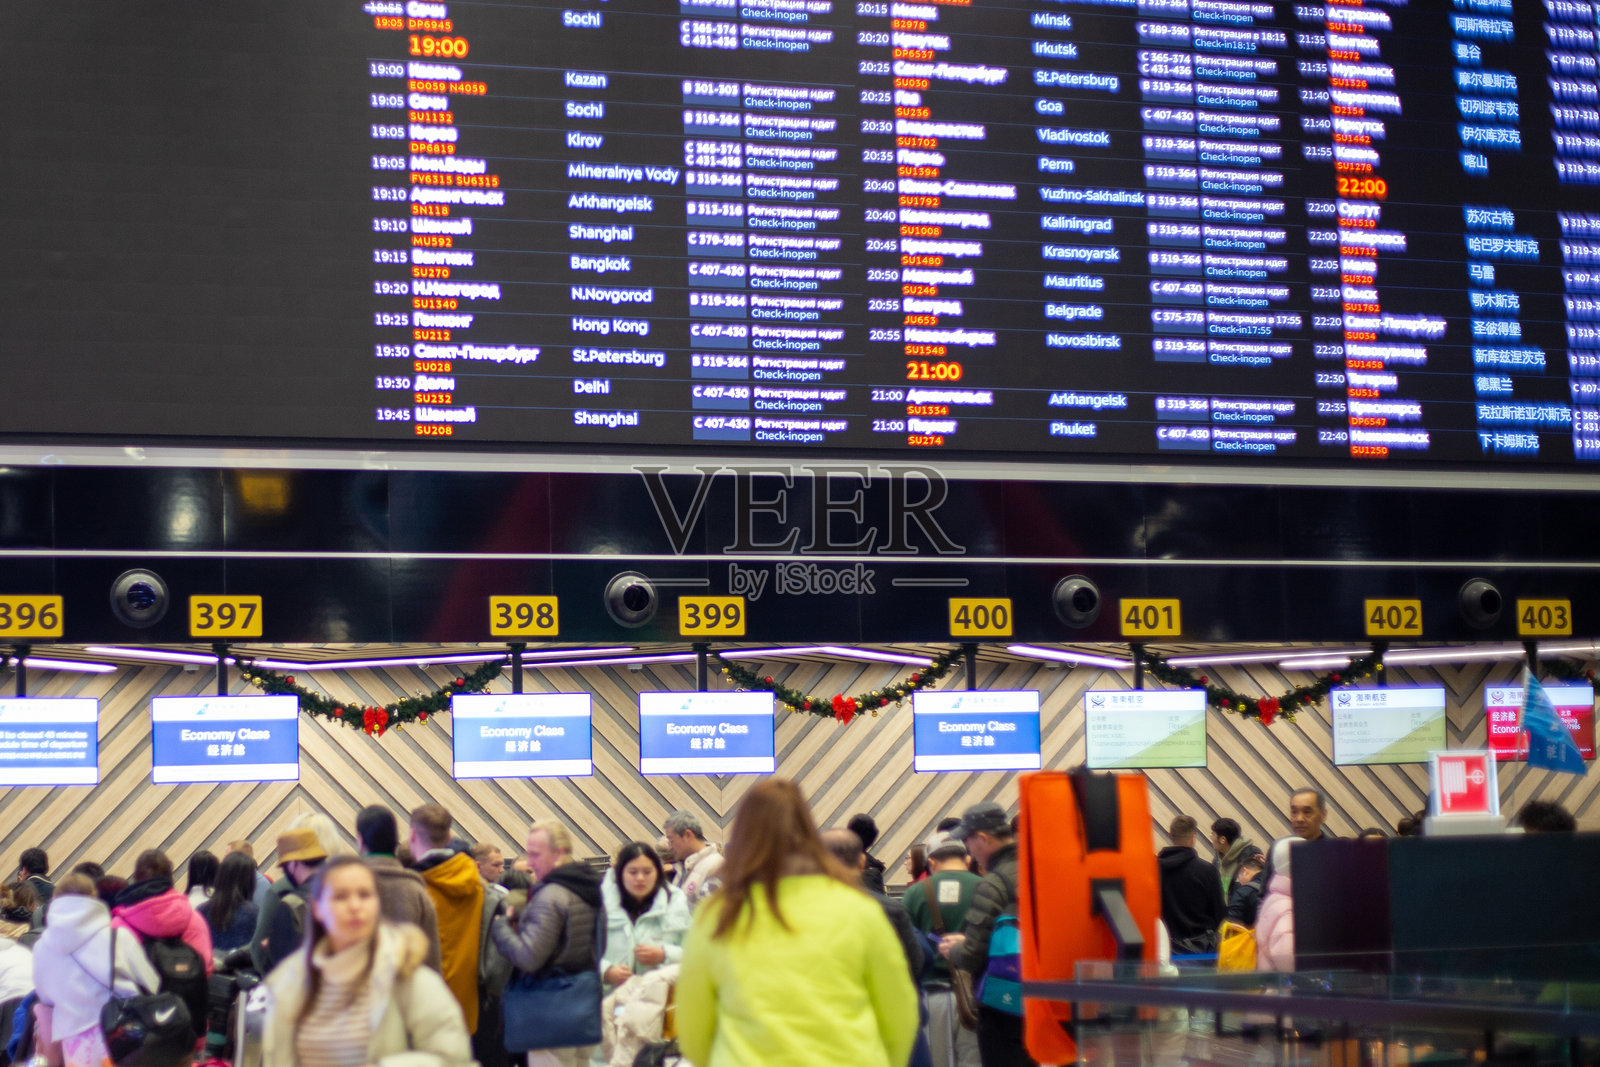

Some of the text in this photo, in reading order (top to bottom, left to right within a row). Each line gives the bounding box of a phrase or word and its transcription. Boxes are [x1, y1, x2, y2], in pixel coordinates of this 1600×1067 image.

[858, 3, 887, 14] 20:15
[1298, 7, 1324, 16] 21:30
[375, 17, 402, 28] 19:05
[409, 19, 452, 31] DP6945
[564, 12, 600, 26] Sochi
[892, 19, 926, 30] B2978
[1034, 14, 1070, 26] Minsk
[1150, 24, 1189, 36] 389-390
[1329, 22, 1363, 32] SU1172
[859, 33, 889, 43] 20:20
[1194, 27, 1248, 39] Регистрация
[1262, 32, 1286, 42] 18:15
[1299, 34, 1326, 44] 21:35
[410, 36, 467, 57] 19:00
[1036, 42, 1076, 55] Irkutsk
[893, 48, 933, 59] DP6537
[372, 64, 404, 76] 19:00
[860, 62, 890, 72] 20:25
[1301, 62, 1328, 72] 21:35
[566, 72, 606, 86] Kazan
[895, 77, 928, 89] SU030
[1036, 71, 1117, 89] St.Petersburg
[450, 83, 487, 95] N4059
[1302, 90, 1329, 100] 21:40
[372, 95, 404, 107] 19:05
[862, 92, 891, 102] 20:25
[567, 103, 602, 117] Sochi
[896, 106, 929, 118] SU236
[1038, 100, 1062, 112] Goa
[410, 110, 452, 123] SU1132
[863, 121, 892, 131] 20:30
[1304, 119, 1331, 128] 21:40
[373, 126, 404, 138] 19:05
[1039, 129, 1109, 143] Vladivostok
[568, 133, 602, 147] Kirov
[897, 136, 936, 148] SU1702
[410, 141, 454, 154] DP6819
[1306, 147, 1333, 156] 21:55
[864, 151, 893, 161] 20:35
[373, 157, 405, 169] 19:05
[1041, 158, 1073, 170] Perm
[569, 164, 678, 185] Mineralnye Vody
[898, 165, 938, 177] SU1394
[411, 172, 499, 187] FV6315 SU6315
[865, 181, 895, 191] 20:40
[1340, 178, 1384, 196] 22:00
[374, 188, 406, 200] 19:10
[1041, 188, 1144, 204] Yuzhno-Sakhalinsk
[569, 195, 652, 212] Arkhangelsk
[900, 195, 939, 206] SU1792
[1308, 203, 1335, 212] 22:00
[866, 210, 896, 221] 20:40
[374, 220, 406, 231] 19:10
[901, 225, 940, 236] SU1008
[1043, 217, 1111, 232] Kaliningrad
[570, 225, 632, 242] Shanghai
[1310, 231, 1337, 241] 22:00
[412, 235, 451, 247] MU592
[867, 240, 896, 250] 20:45
[375, 251, 407, 262] 19:15
[1044, 246, 1118, 261] Krasnoyarsk
[571, 256, 629, 272] Bangkok
[902, 255, 942, 265] SU1480
[1312, 259, 1339, 270] 22:05
[413, 266, 449, 277] SU270
[868, 270, 898, 280] 20:50
[1046, 276, 1103, 288] Mauritius
[376, 283, 408, 294] 19:20
[903, 284, 937, 295] SU246
[1313, 288, 1340, 299] 22:10
[572, 288, 652, 303] N.Novgorod
[414, 297, 457, 309] SU1340
[869, 300, 899, 310] 20:55
[1047, 305, 1102, 319] Belgrade
[376, 314, 408, 325] 19:25
[905, 315, 937, 325] JU653
[1315, 316, 1342, 327] 22:20
[573, 318, 648, 335] Hong Kong
[414, 329, 449, 340] SU212
[870, 330, 900, 340] 20:55
[1048, 335, 1120, 347] Novosibirsk
[377, 346, 409, 357] 19:30
[906, 344, 945, 355] SU1548
[1317, 344, 1344, 355] 22:20
[573, 349, 664, 366] St.Petersburg
[415, 360, 451, 371] SU028
[908, 362, 960, 380] 21:00
[377, 378, 409, 388] 19:30
[1318, 372, 1345, 383] 22:30
[575, 381, 609, 393] Delhi
[415, 392, 451, 403] SU232
[872, 391, 903, 400] 21:00
[1050, 393, 1126, 408] Arkhangelsk
[908, 405, 948, 415] SU1334
[1320, 401, 1347, 412] 22:35
[378, 410, 410, 420] 19:45
[575, 412, 637, 427] Shanghai
[416, 424, 452, 435] SU208
[873, 421, 904, 430] 21:00
[1052, 423, 1095, 434] Phuket
[909, 435, 943, 445] SU274
[1322, 430, 1349, 441] 22:40
[0, 603, 58, 629] 396
[195, 602, 257, 629] 397
[495, 602, 554, 628] 398
[683, 602, 741, 629] 399
[954, 605, 1007, 630] 400
[1125, 605, 1174, 630] 401
[1370, 604, 1419, 629] 402
[1522, 605, 1567, 629] 403
[480, 724, 564, 738] Economy Class
[666, 722, 748, 737] Economy Class
[938, 720, 1016, 733] Economy Class
[181, 727, 270, 742] Economy Class
